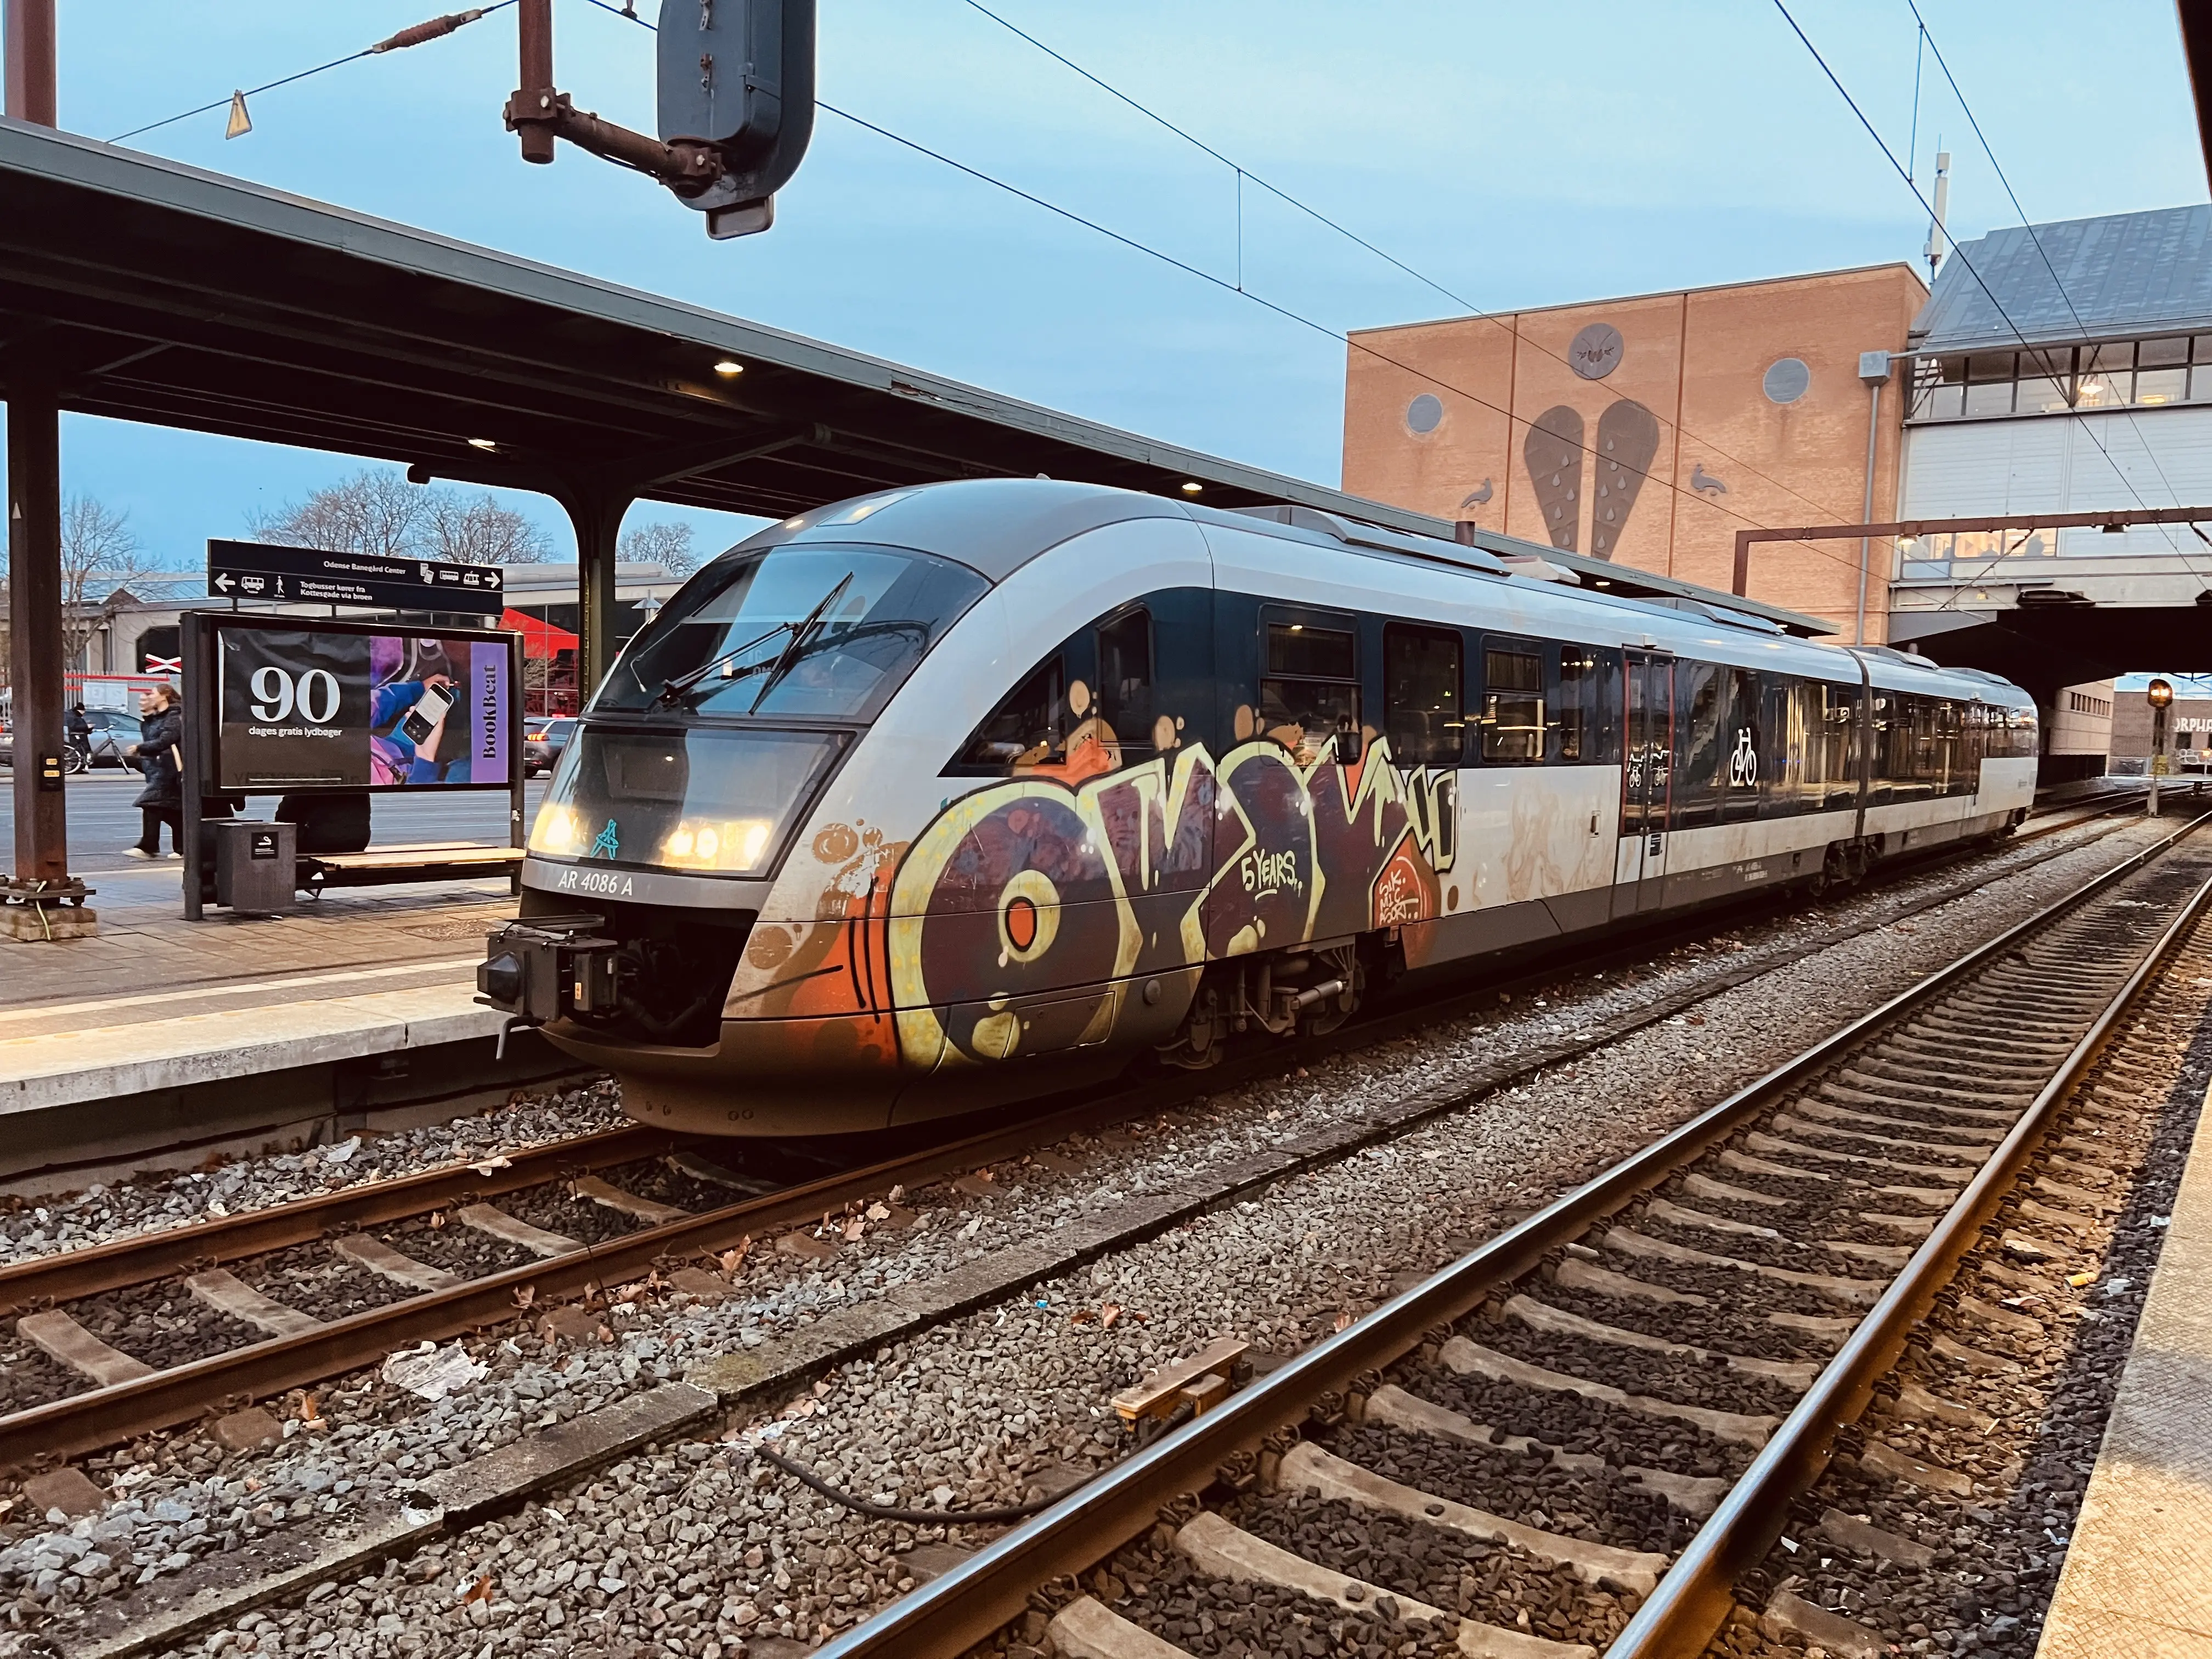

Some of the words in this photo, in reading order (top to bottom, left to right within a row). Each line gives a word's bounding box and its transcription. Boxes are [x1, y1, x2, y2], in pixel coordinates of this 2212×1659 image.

[324, 561, 350, 569] Odense
[352, 563, 383, 572] Banegård
[300, 581, 335, 590] Togbusser
[250, 667, 341, 723] 90
[483, 664, 496, 759] BookBeat
[249, 726, 277, 737] dages
[278, 727, 303, 737] gratis
[558, 870, 578, 889] AR
[580, 872, 618, 894] 4086
[620, 877, 632, 896] A
[1241, 856, 1255, 891] 5
